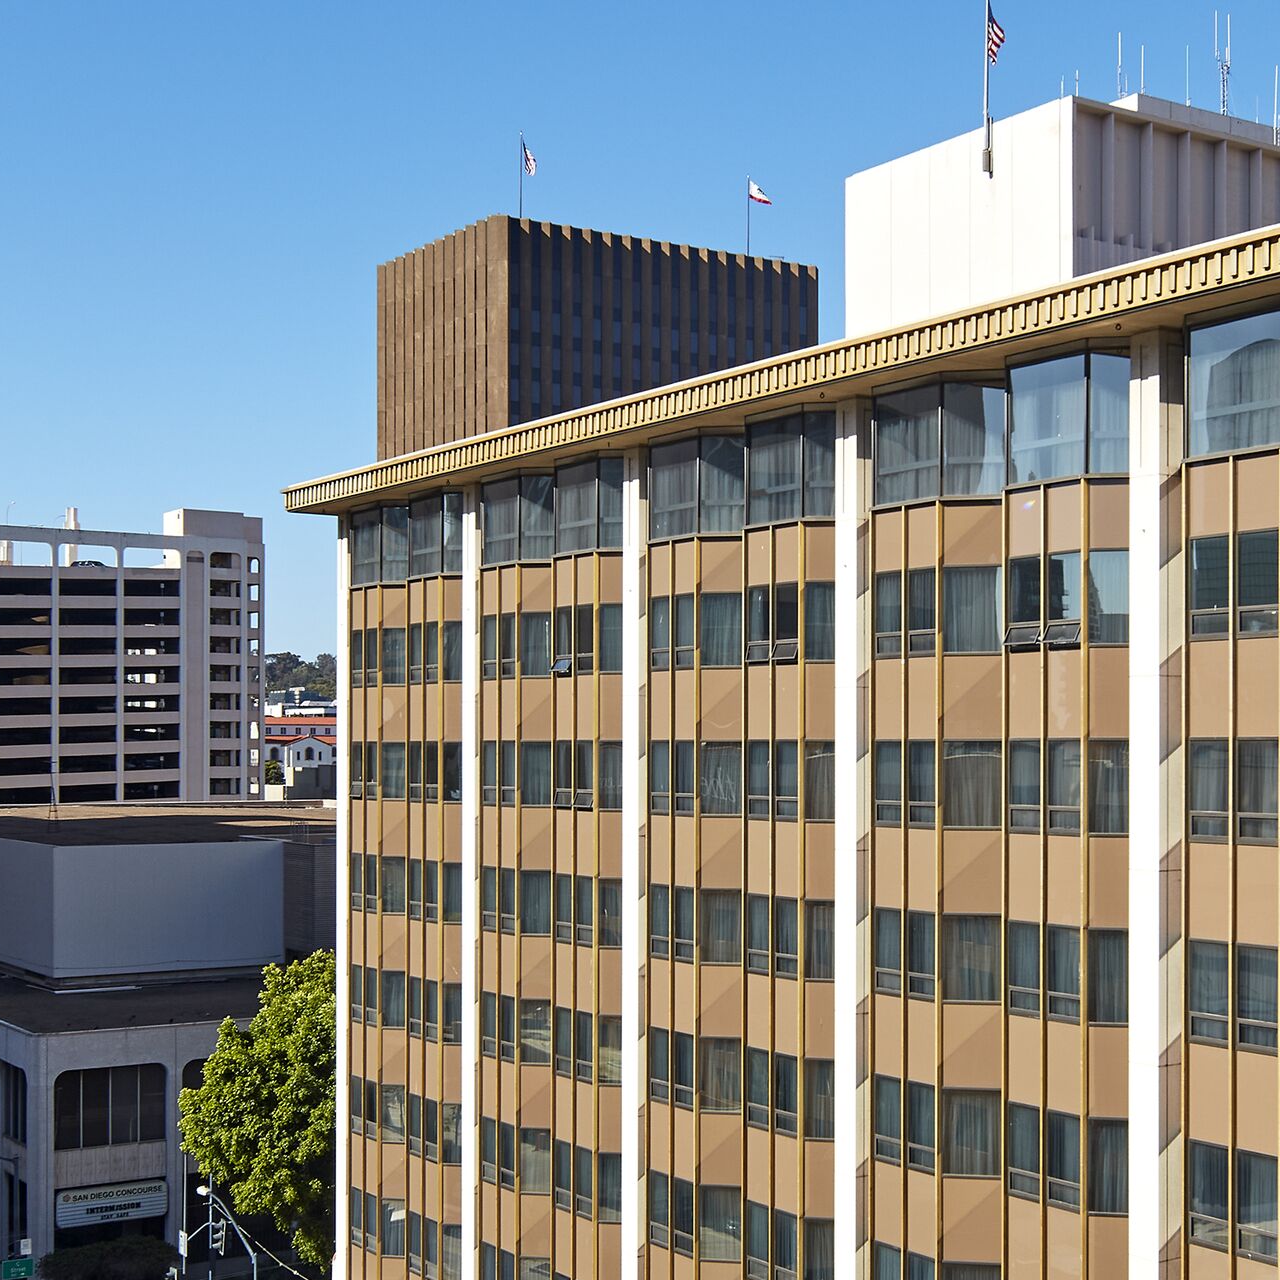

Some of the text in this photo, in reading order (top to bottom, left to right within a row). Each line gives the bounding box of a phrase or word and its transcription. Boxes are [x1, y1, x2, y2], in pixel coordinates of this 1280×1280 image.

[72, 1185, 162, 1203] SAN DIEGO CONCOURSE
[86, 1202, 141, 1215] INTERMISSION
